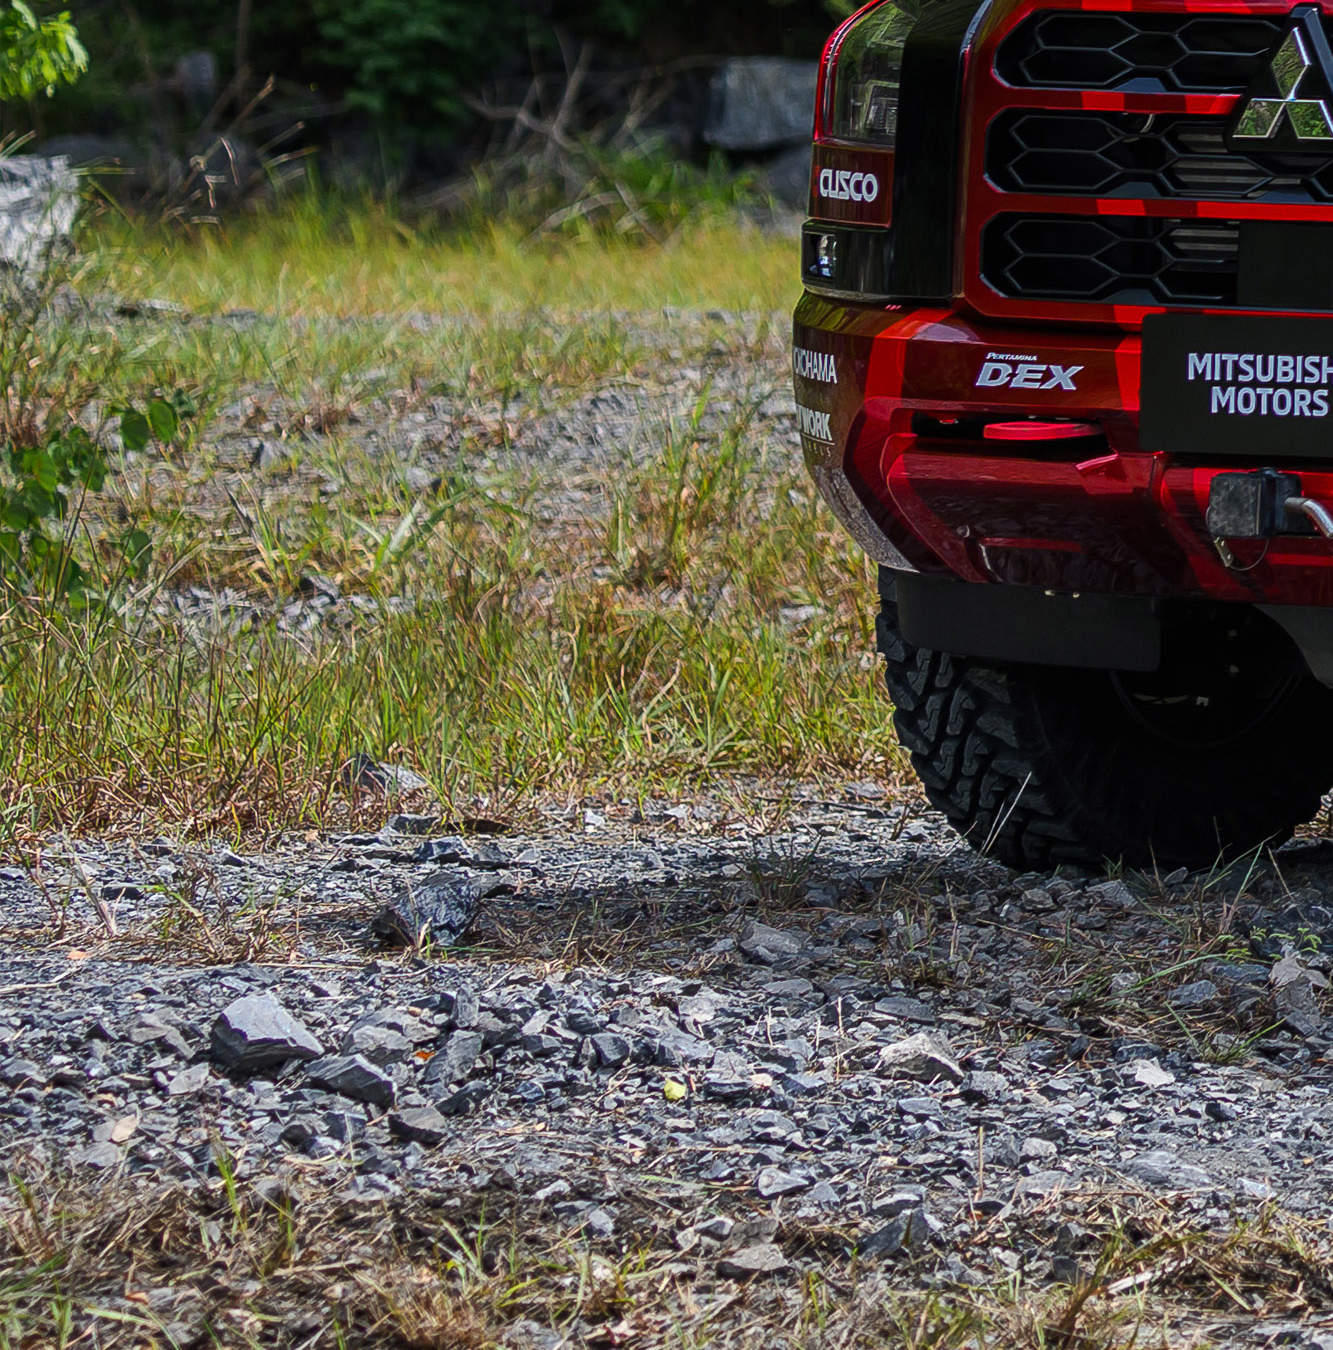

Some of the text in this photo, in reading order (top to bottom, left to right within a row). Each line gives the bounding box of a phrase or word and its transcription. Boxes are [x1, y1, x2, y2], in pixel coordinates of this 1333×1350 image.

[819, 168, 879, 202] CUSCO
[976, 362, 1084, 390] DEX
[1210, 387, 1329, 418] MOTORS
